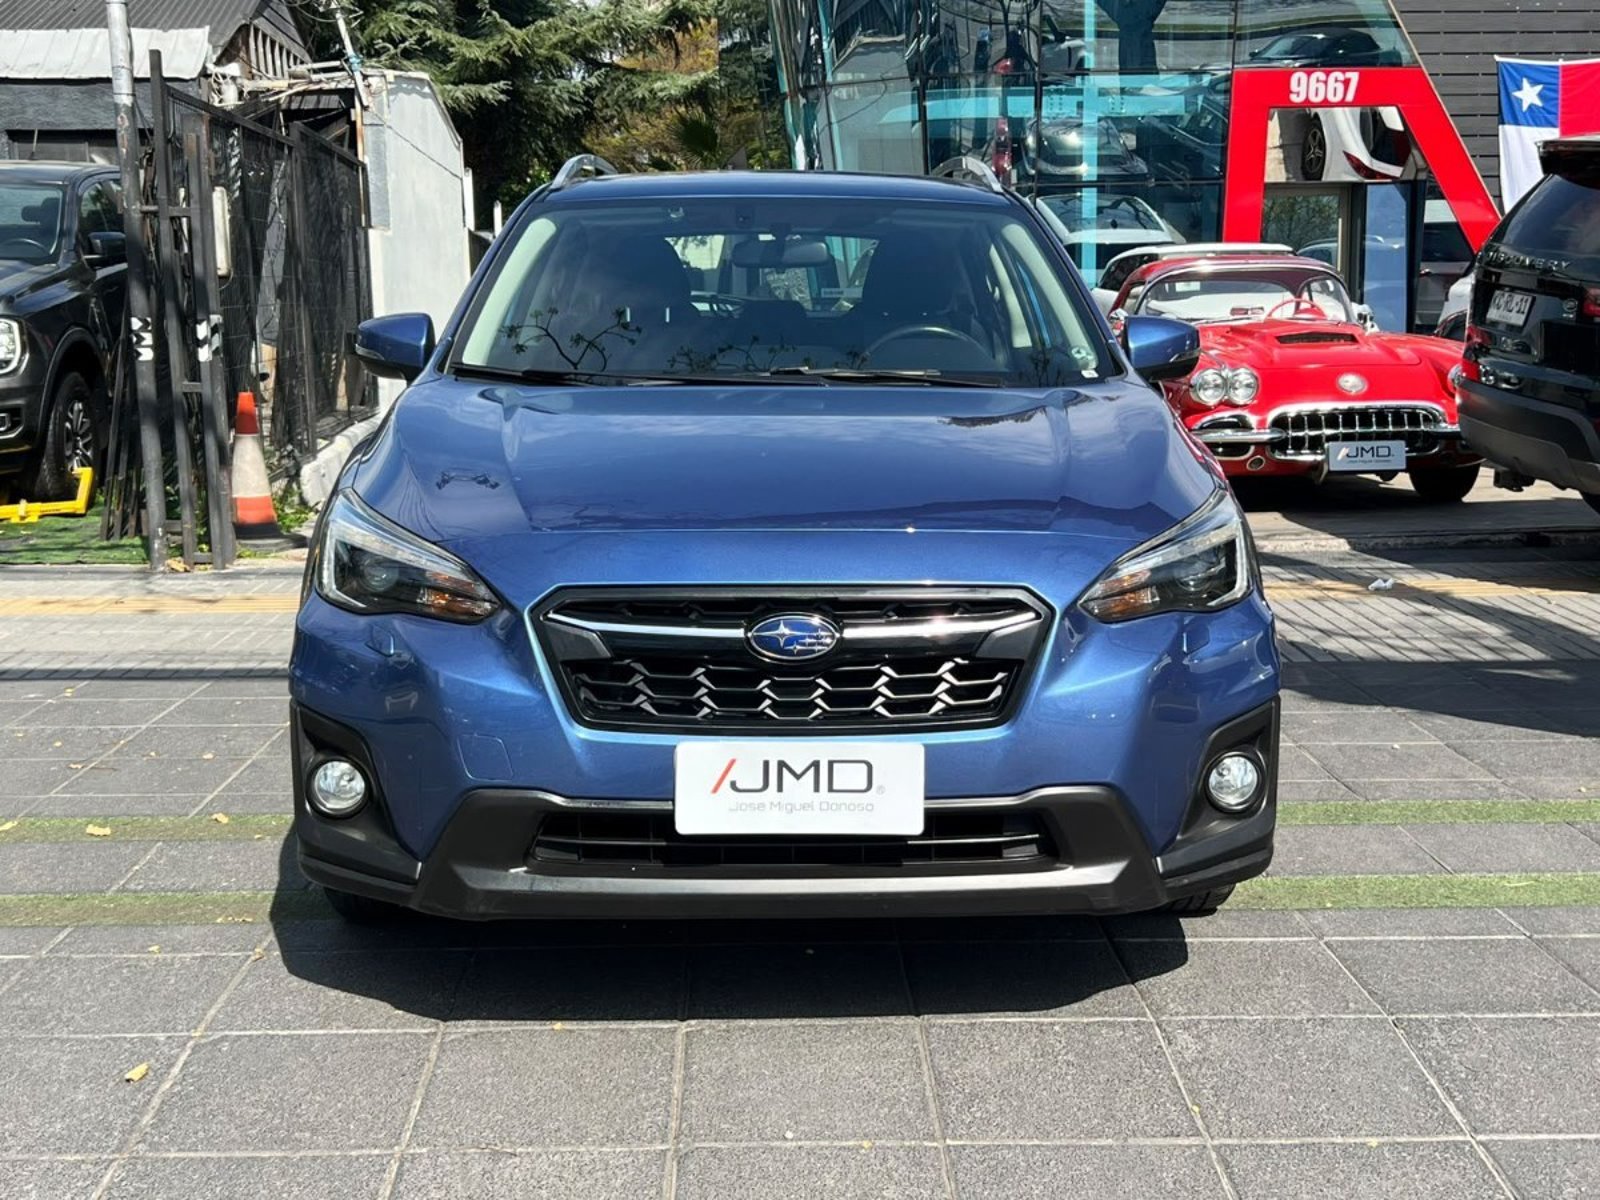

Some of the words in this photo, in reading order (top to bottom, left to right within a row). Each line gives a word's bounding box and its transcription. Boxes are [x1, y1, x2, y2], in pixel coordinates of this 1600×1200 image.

[1289, 71, 1360, 103] 9667
[729, 801, 766, 812] Jose
[769, 801, 814, 814] Miguel
[819, 801, 874, 812] Donoso
